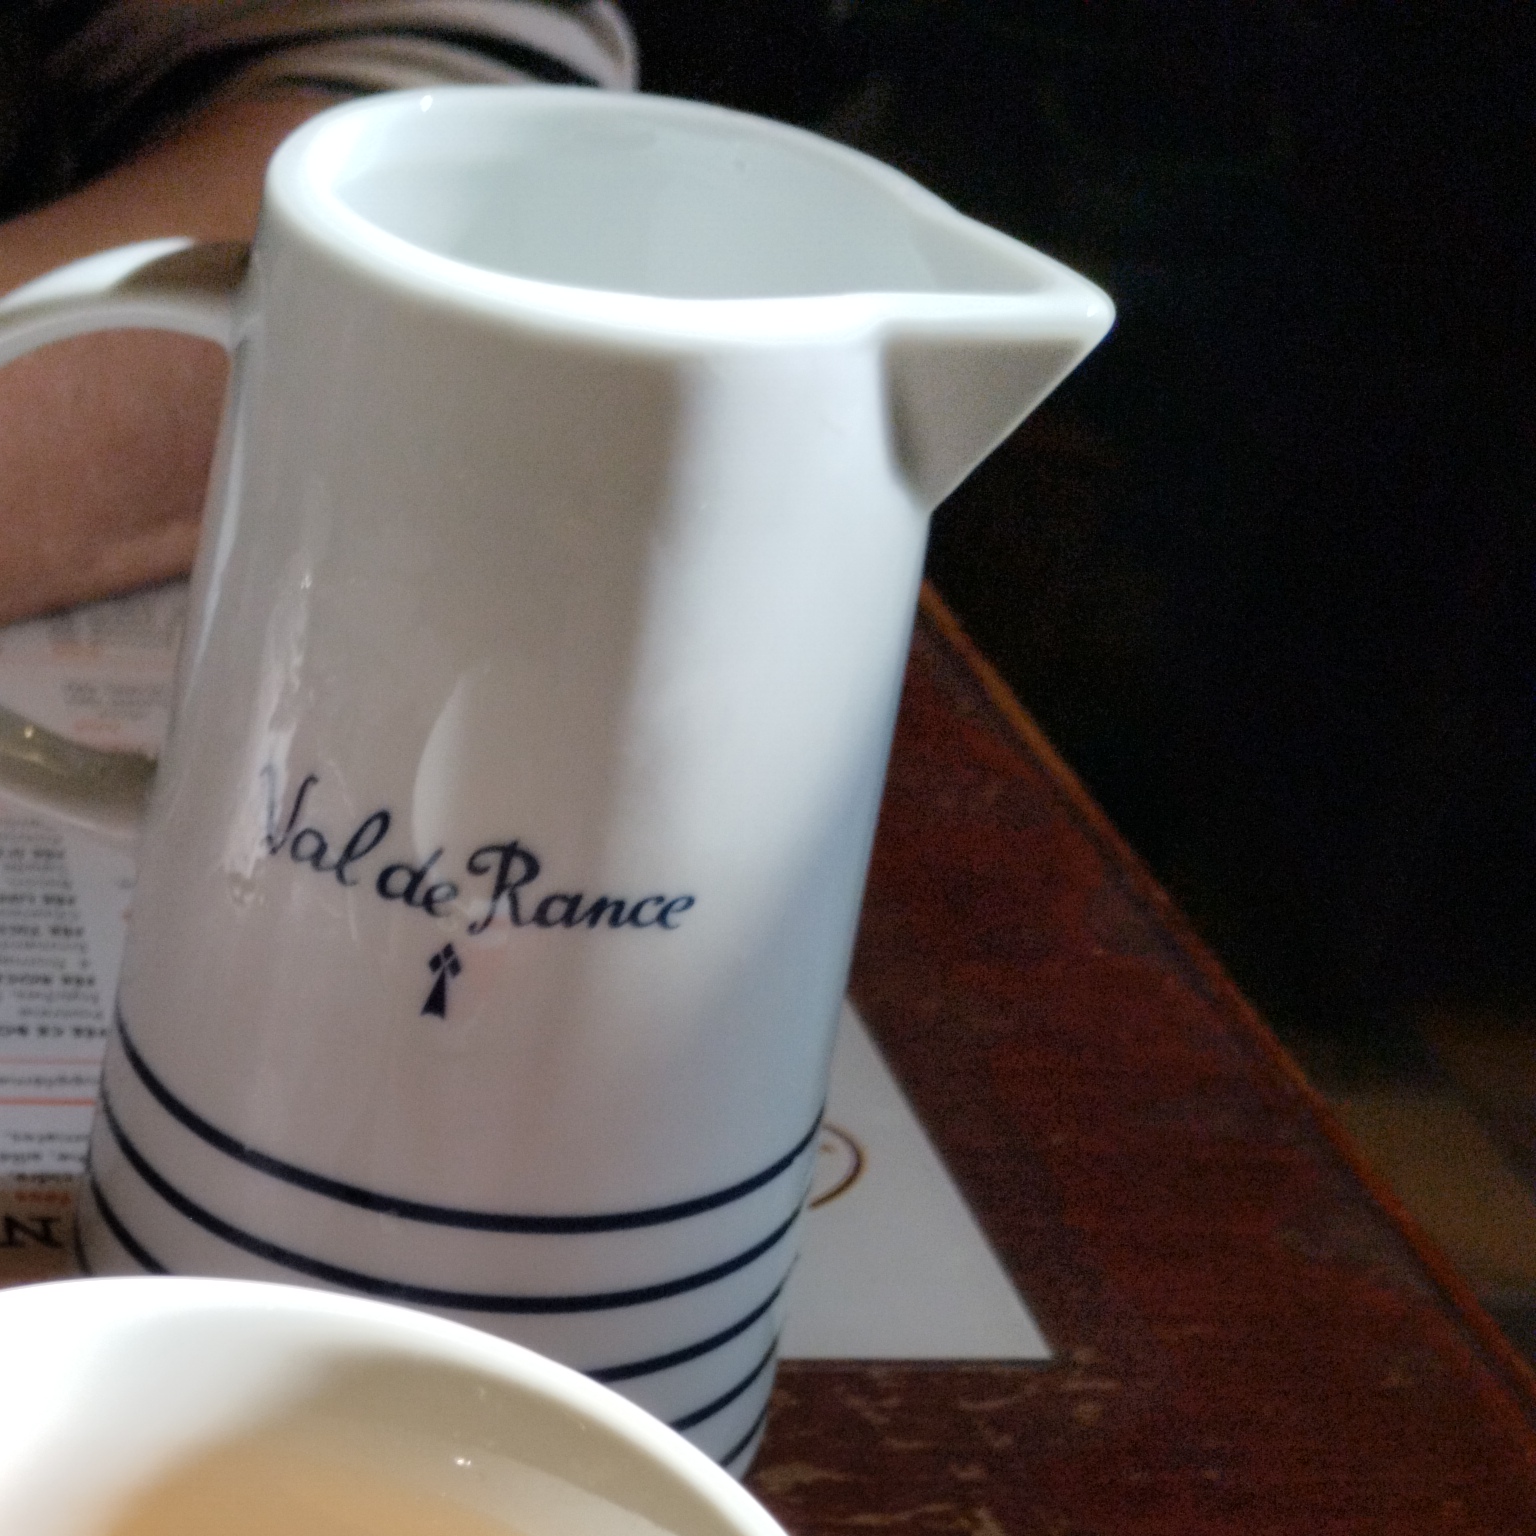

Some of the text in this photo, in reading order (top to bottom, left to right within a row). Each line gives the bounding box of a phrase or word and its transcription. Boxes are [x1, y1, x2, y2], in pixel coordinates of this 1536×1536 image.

[260, 763, 695, 935] Val de Rance
